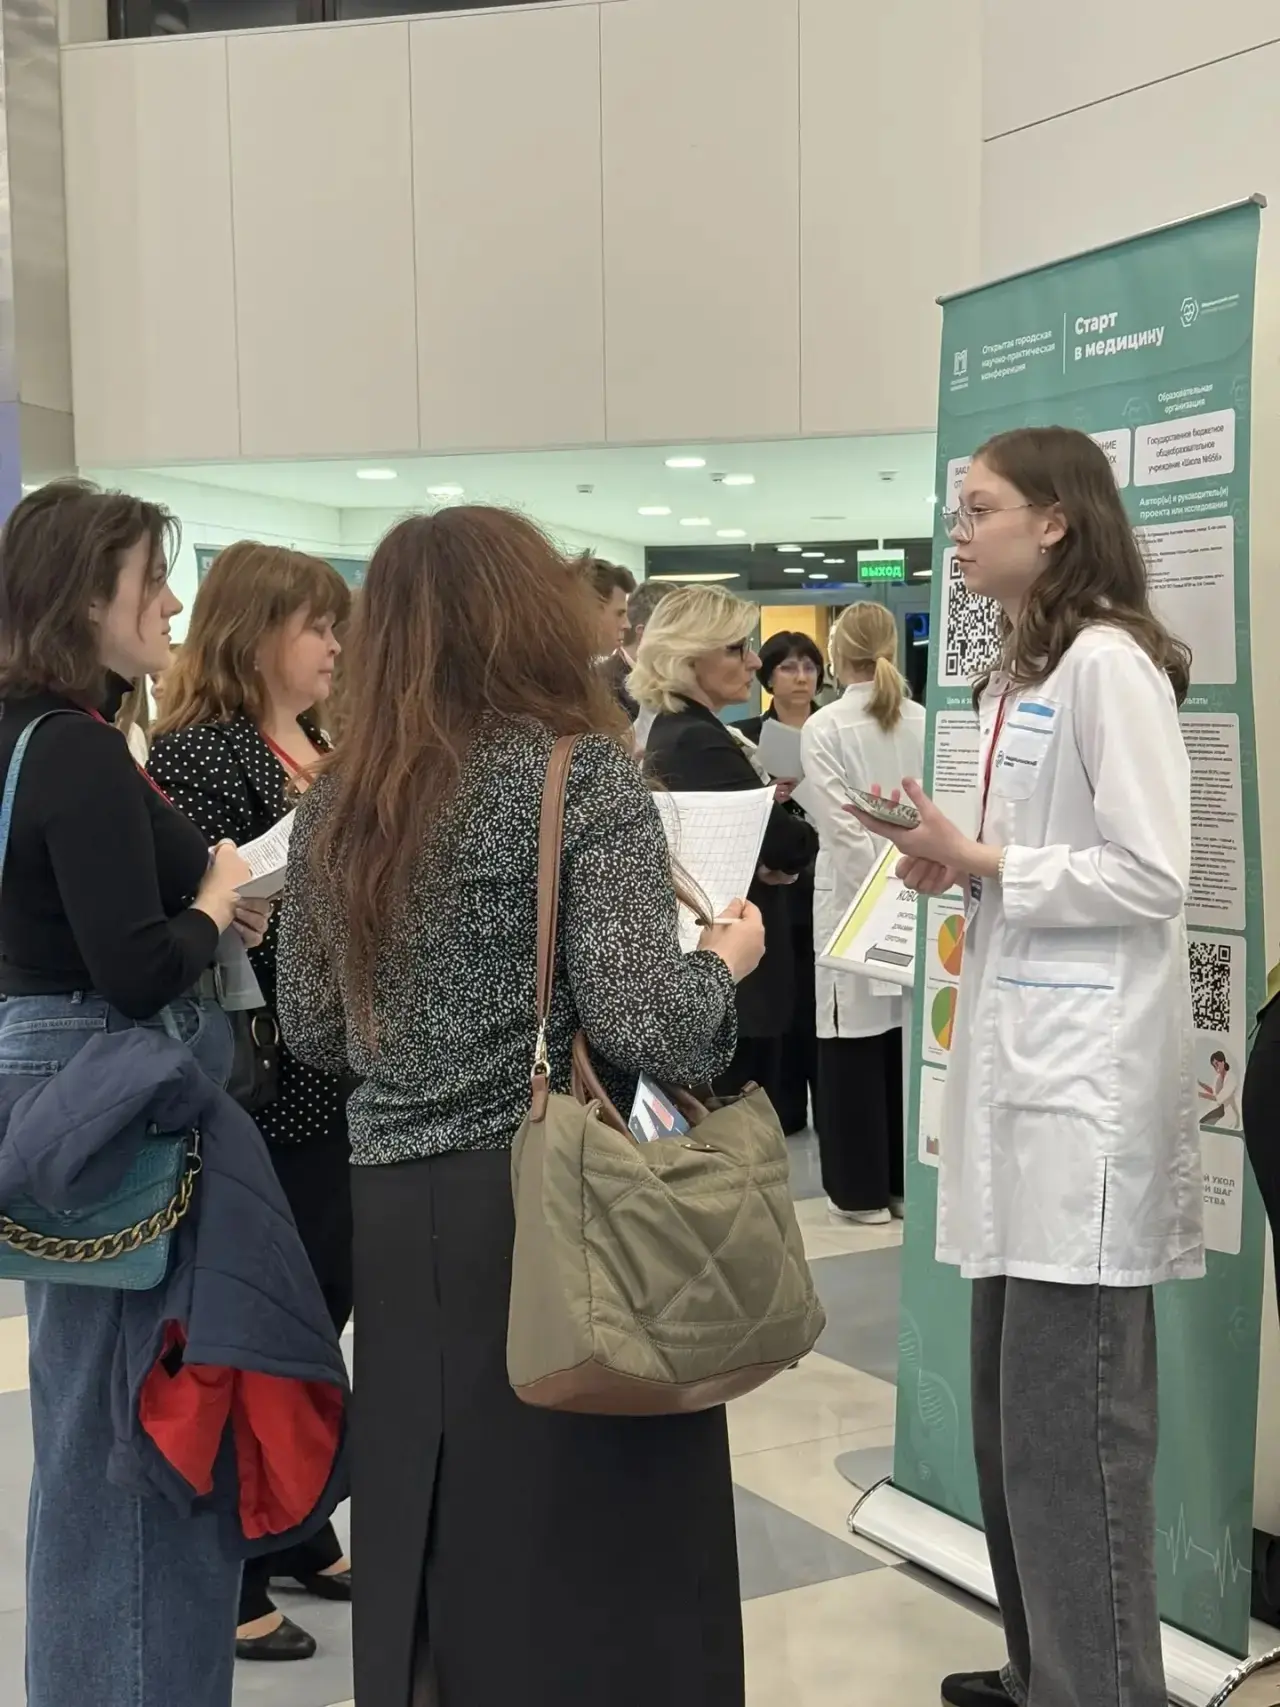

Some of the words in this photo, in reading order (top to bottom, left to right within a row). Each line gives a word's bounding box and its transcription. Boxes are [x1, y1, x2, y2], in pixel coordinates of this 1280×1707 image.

[1074, 311, 1119, 335] Старт
[1015, 330, 1052, 347] городская
[1074, 346, 1082, 361] в
[1085, 326, 1165, 358] медицину
[981, 343, 1056, 368] научно-практическая
[1157, 383, 1214, 403] Образовательная
[1164, 398, 1206, 415] организация
[1147, 431, 1192, 446] Государственное
[1192, 425, 1225, 437] бюджетное
[1100, 440, 1117, 450] НИЕ
[1139, 508, 1170, 520] проекта
[1171, 507, 1183, 515] или
[1184, 500, 1228, 513] исследования
[861, 566, 902, 578] ВЫХОД
[1212, 1175, 1235, 1187] УКОЛ
[1213, 1186, 1233, 1196] ШАГ
